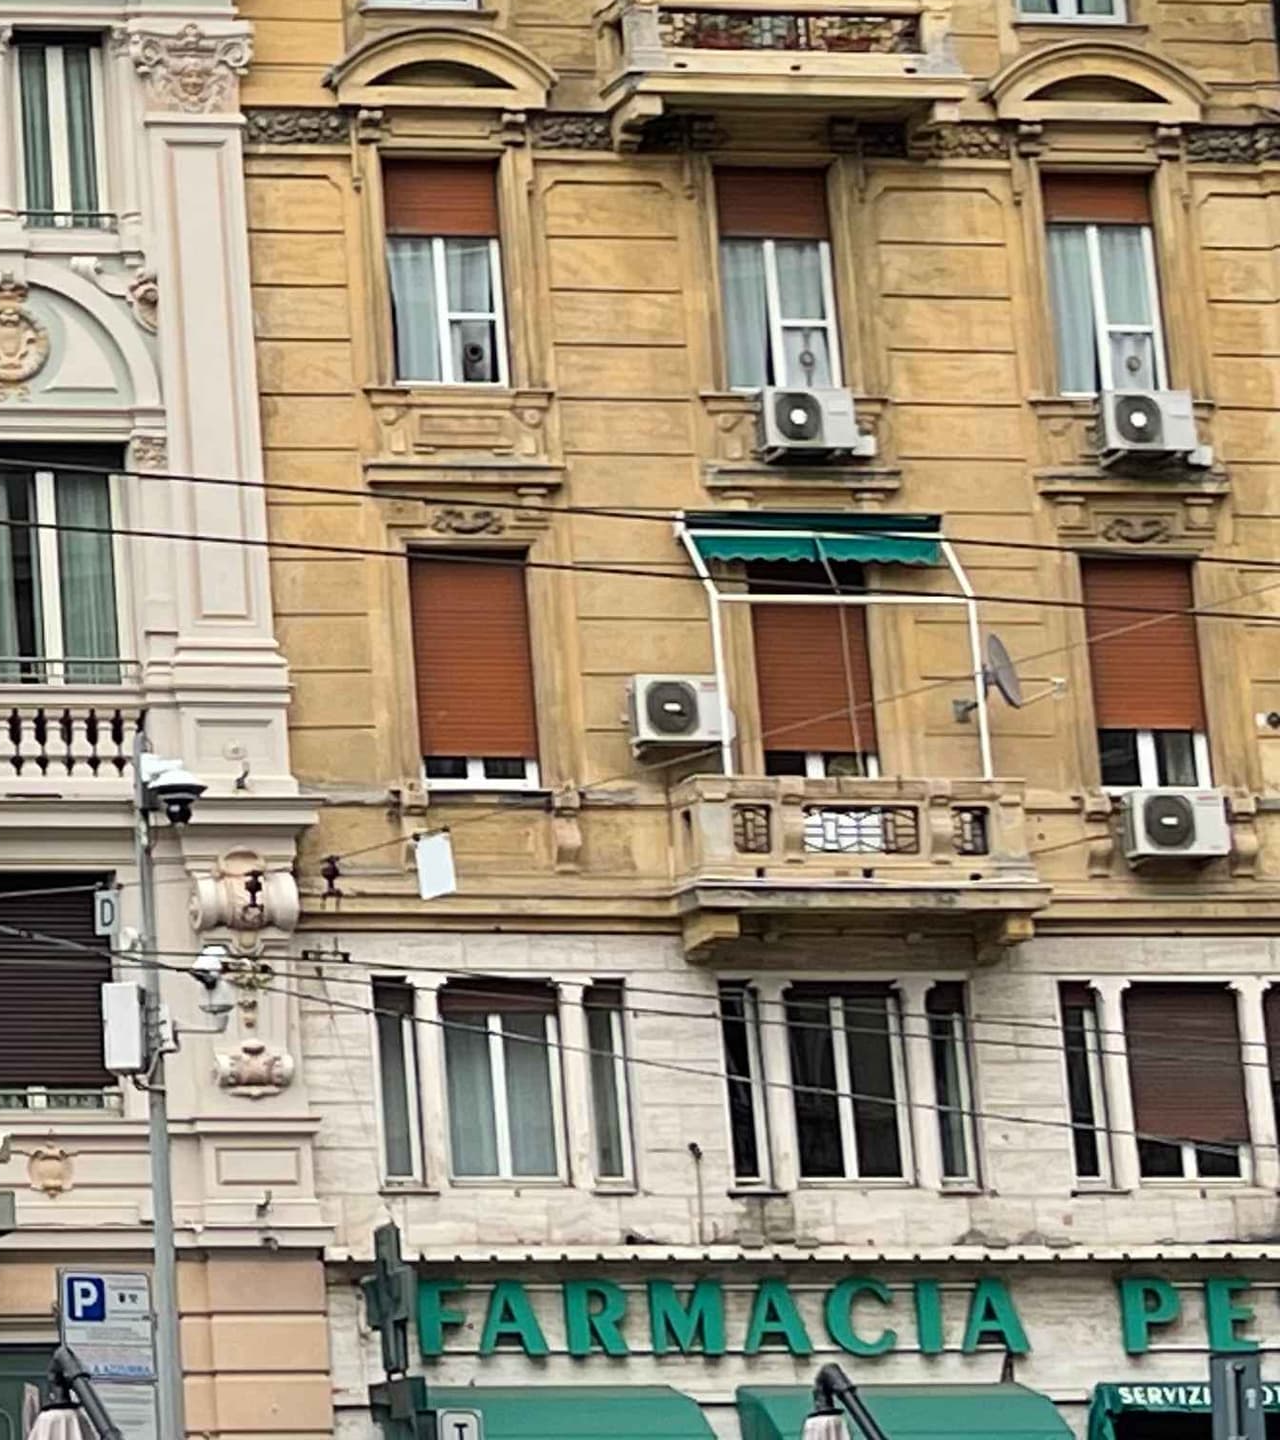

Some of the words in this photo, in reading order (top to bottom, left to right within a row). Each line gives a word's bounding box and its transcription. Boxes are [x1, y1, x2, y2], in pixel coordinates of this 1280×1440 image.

[72, 1280, 99, 1318] P
[417, 1277, 1032, 1357] FARMACIA
[1120, 1277, 1262, 1354] PE
[1117, 1386, 1212, 1406] SERVIZI
